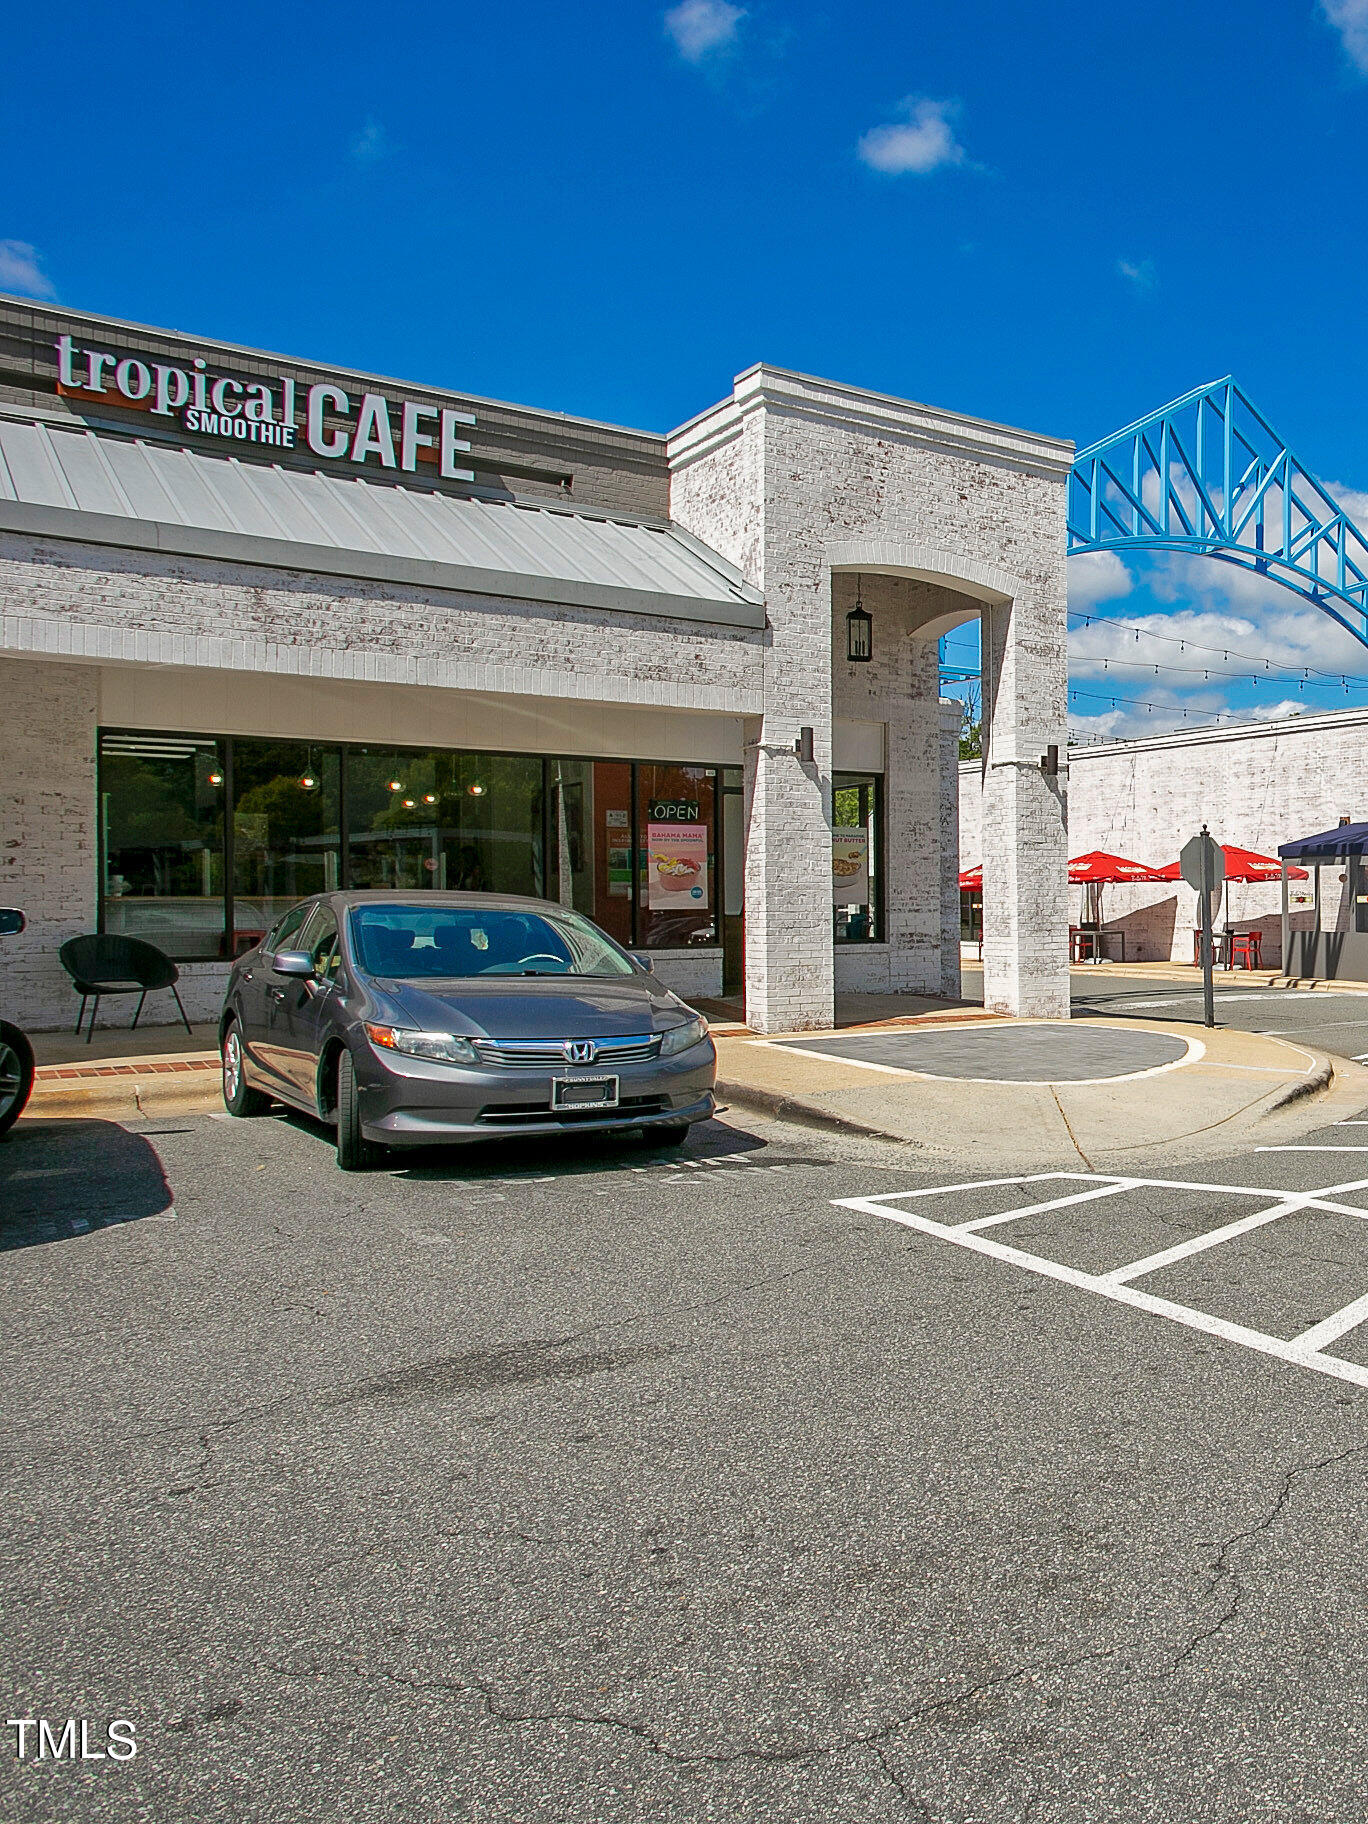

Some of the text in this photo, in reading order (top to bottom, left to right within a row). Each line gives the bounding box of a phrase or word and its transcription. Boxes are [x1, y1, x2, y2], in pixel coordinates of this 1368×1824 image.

[54, 335, 299, 429] tropical
[185, 410, 295, 449] SMOOTHIE
[306, 383, 477, 482] CAFE
[654, 805, 699, 820] OPEN
